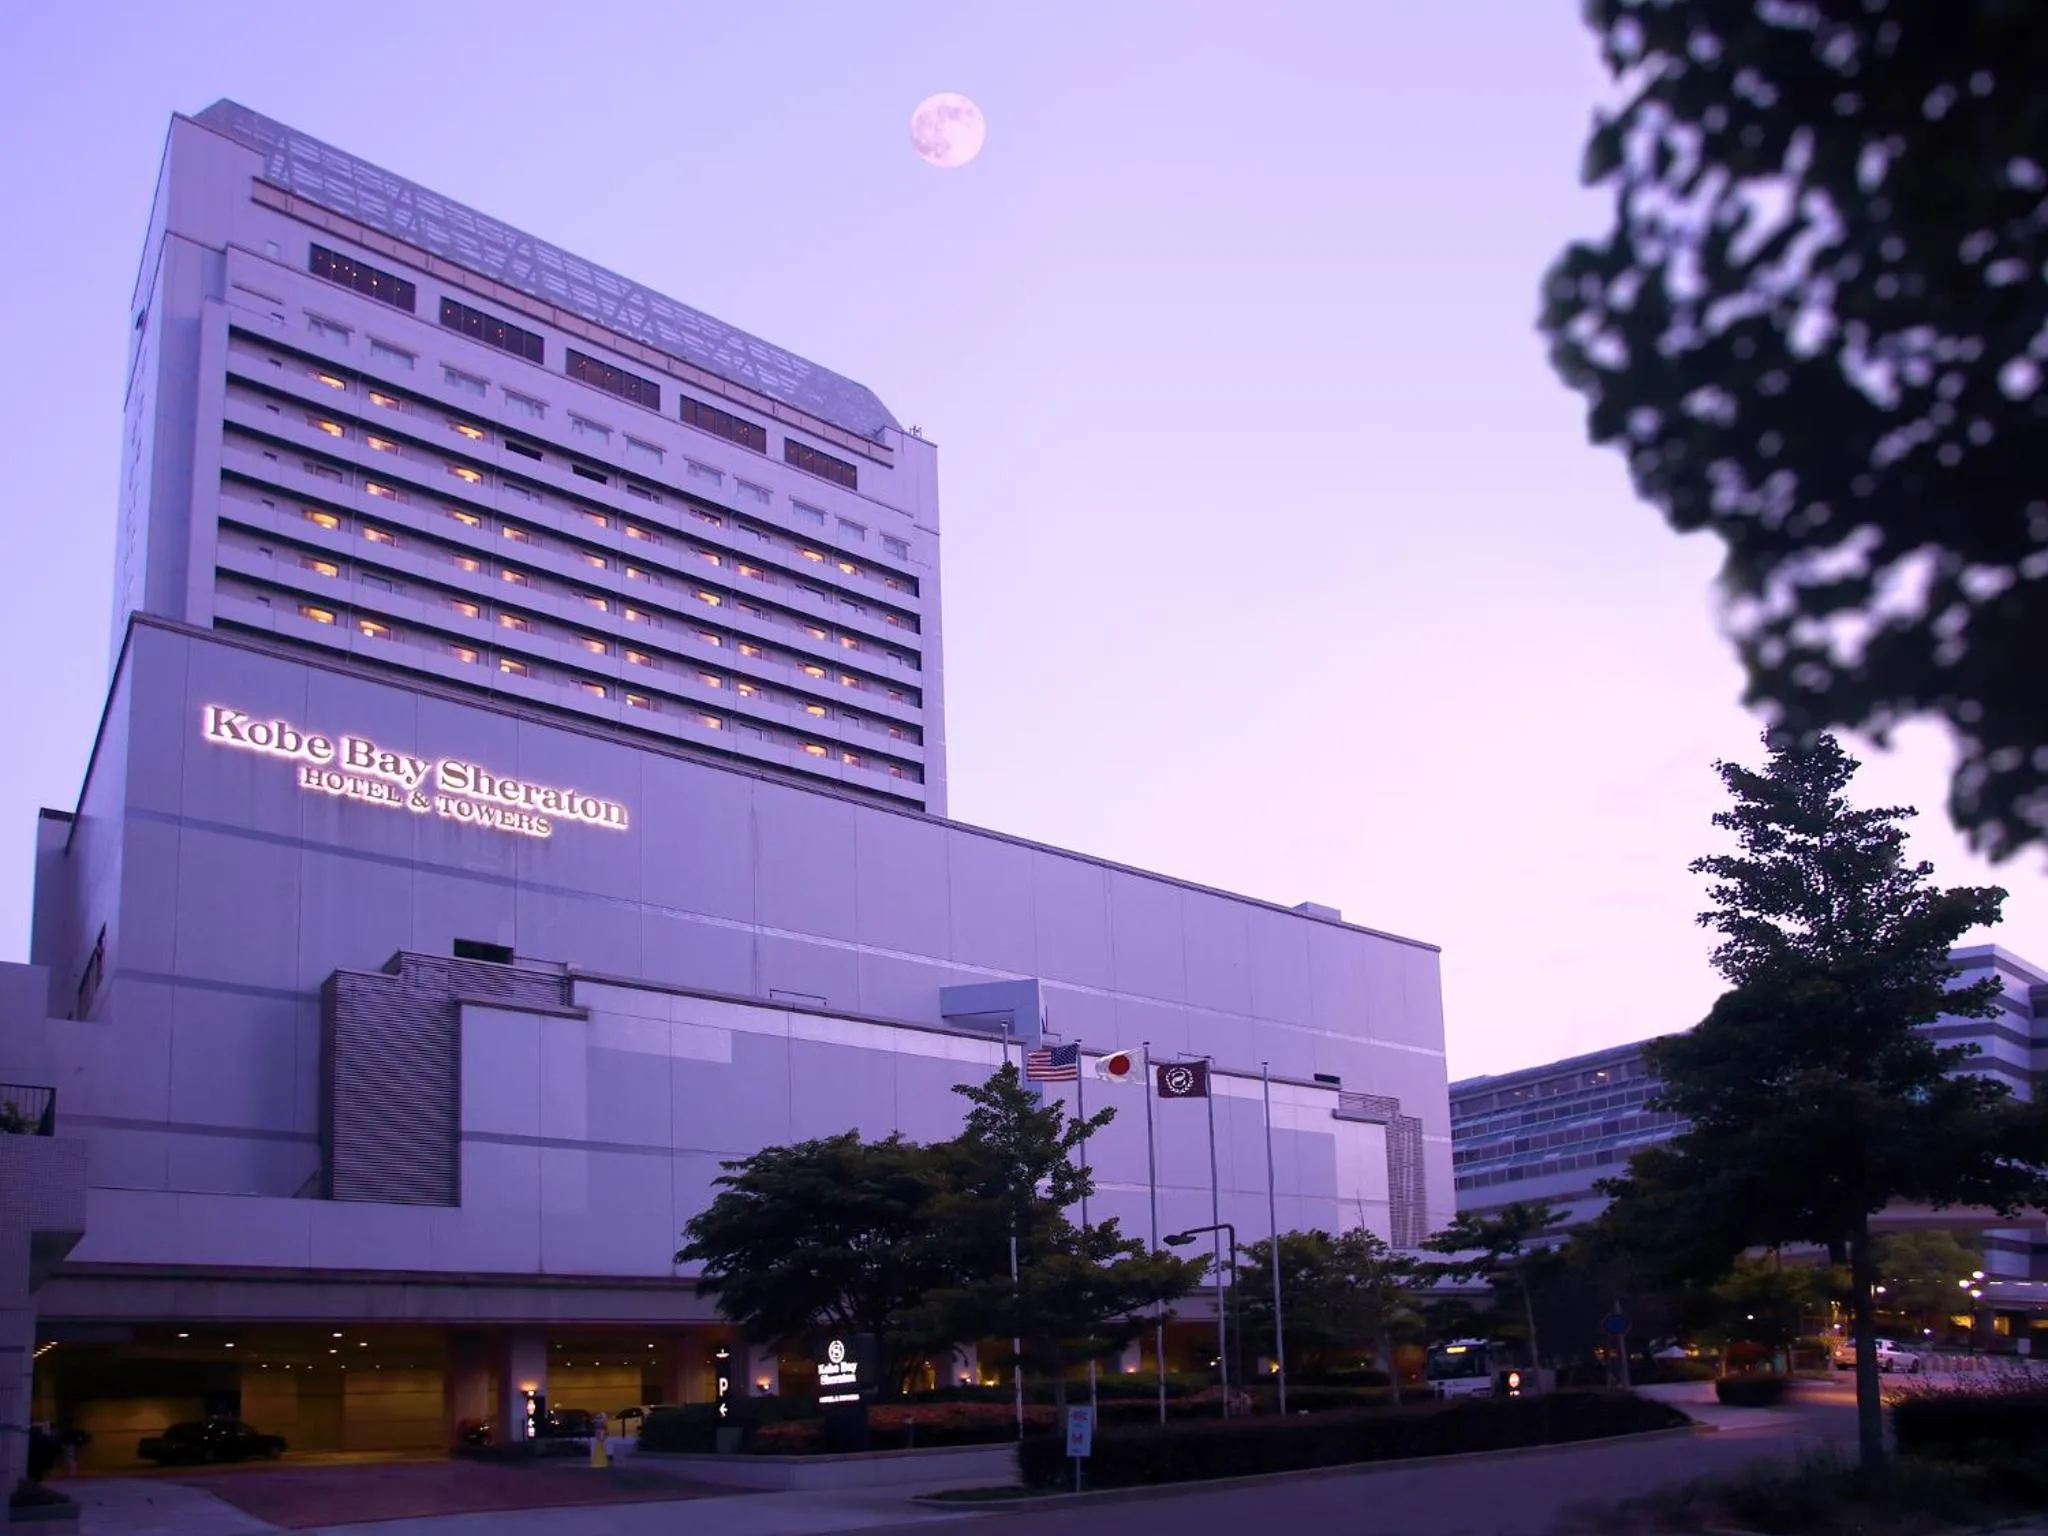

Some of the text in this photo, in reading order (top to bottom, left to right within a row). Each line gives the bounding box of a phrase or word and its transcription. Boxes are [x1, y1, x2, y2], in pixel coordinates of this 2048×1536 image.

[208, 705, 629, 827] Kobe Bay Sheraton
[304, 766, 552, 836] HOTEL & TOWERS
[719, 1377, 729, 1397] P
